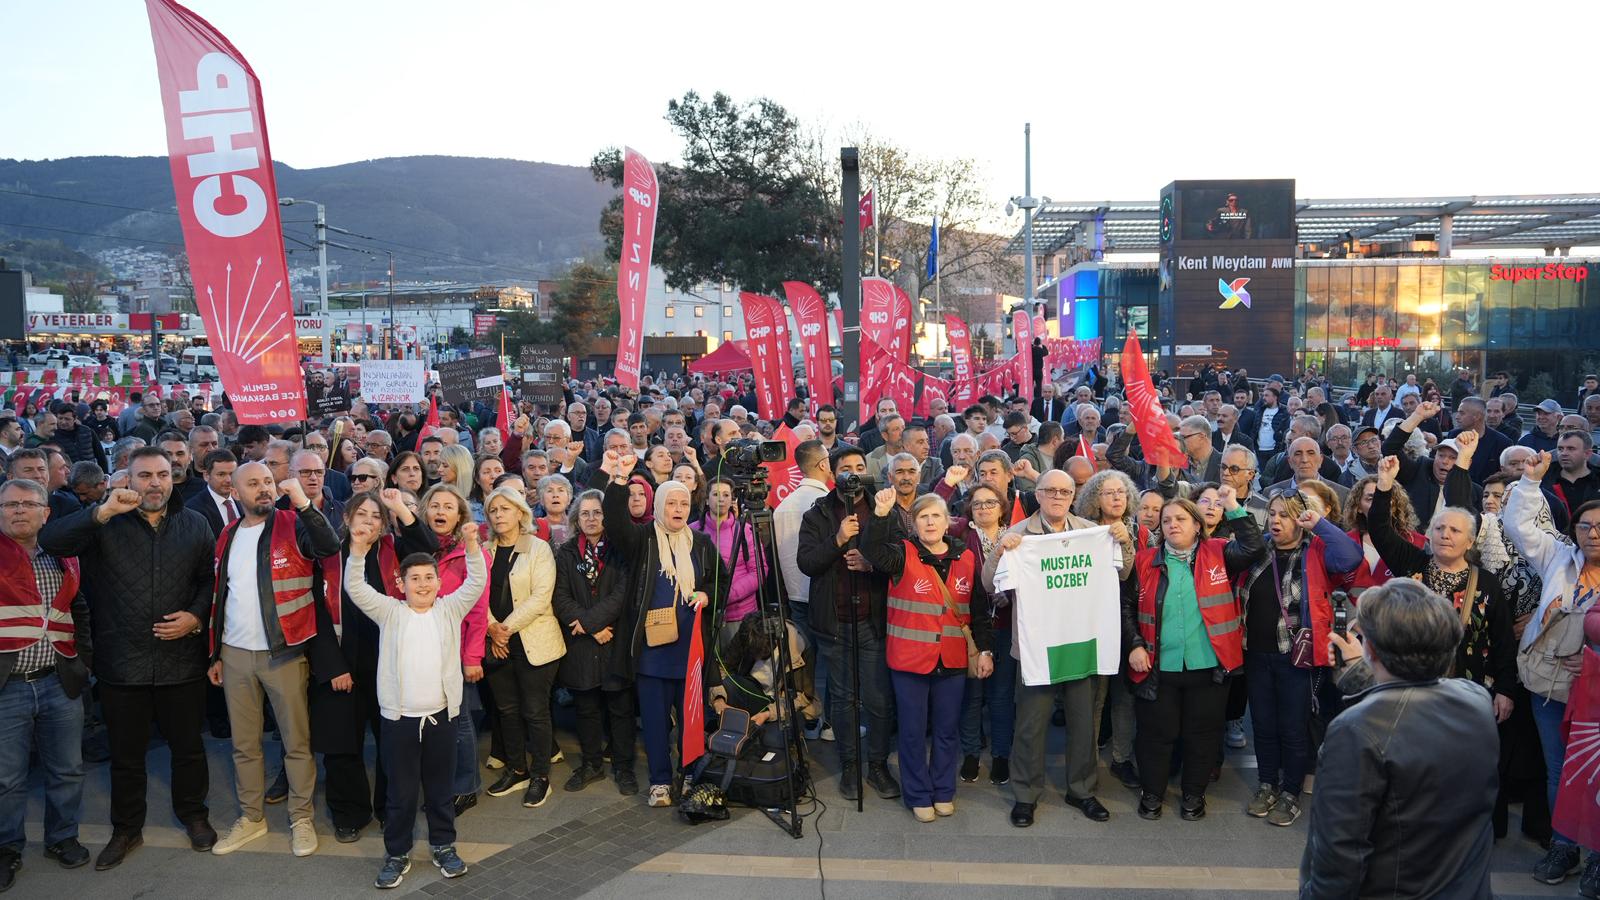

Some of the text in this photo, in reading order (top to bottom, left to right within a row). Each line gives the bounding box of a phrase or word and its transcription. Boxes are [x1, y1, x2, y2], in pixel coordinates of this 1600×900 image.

[1178, 255, 1292, 271] Kent Meydanı AVM
[1489, 263, 1589, 283] SuperStep
[42, 315, 113, 326] YETERLER
[750, 326, 771, 339] CHP
[802, 323, 821, 337] CHP
[757, 344, 774, 420] NİLÜF
[776, 340, 789, 410] NİLÜF
[1041, 554, 1092, 571] MUSTAFA
[1046, 572, 1088, 589] BOZBEY
